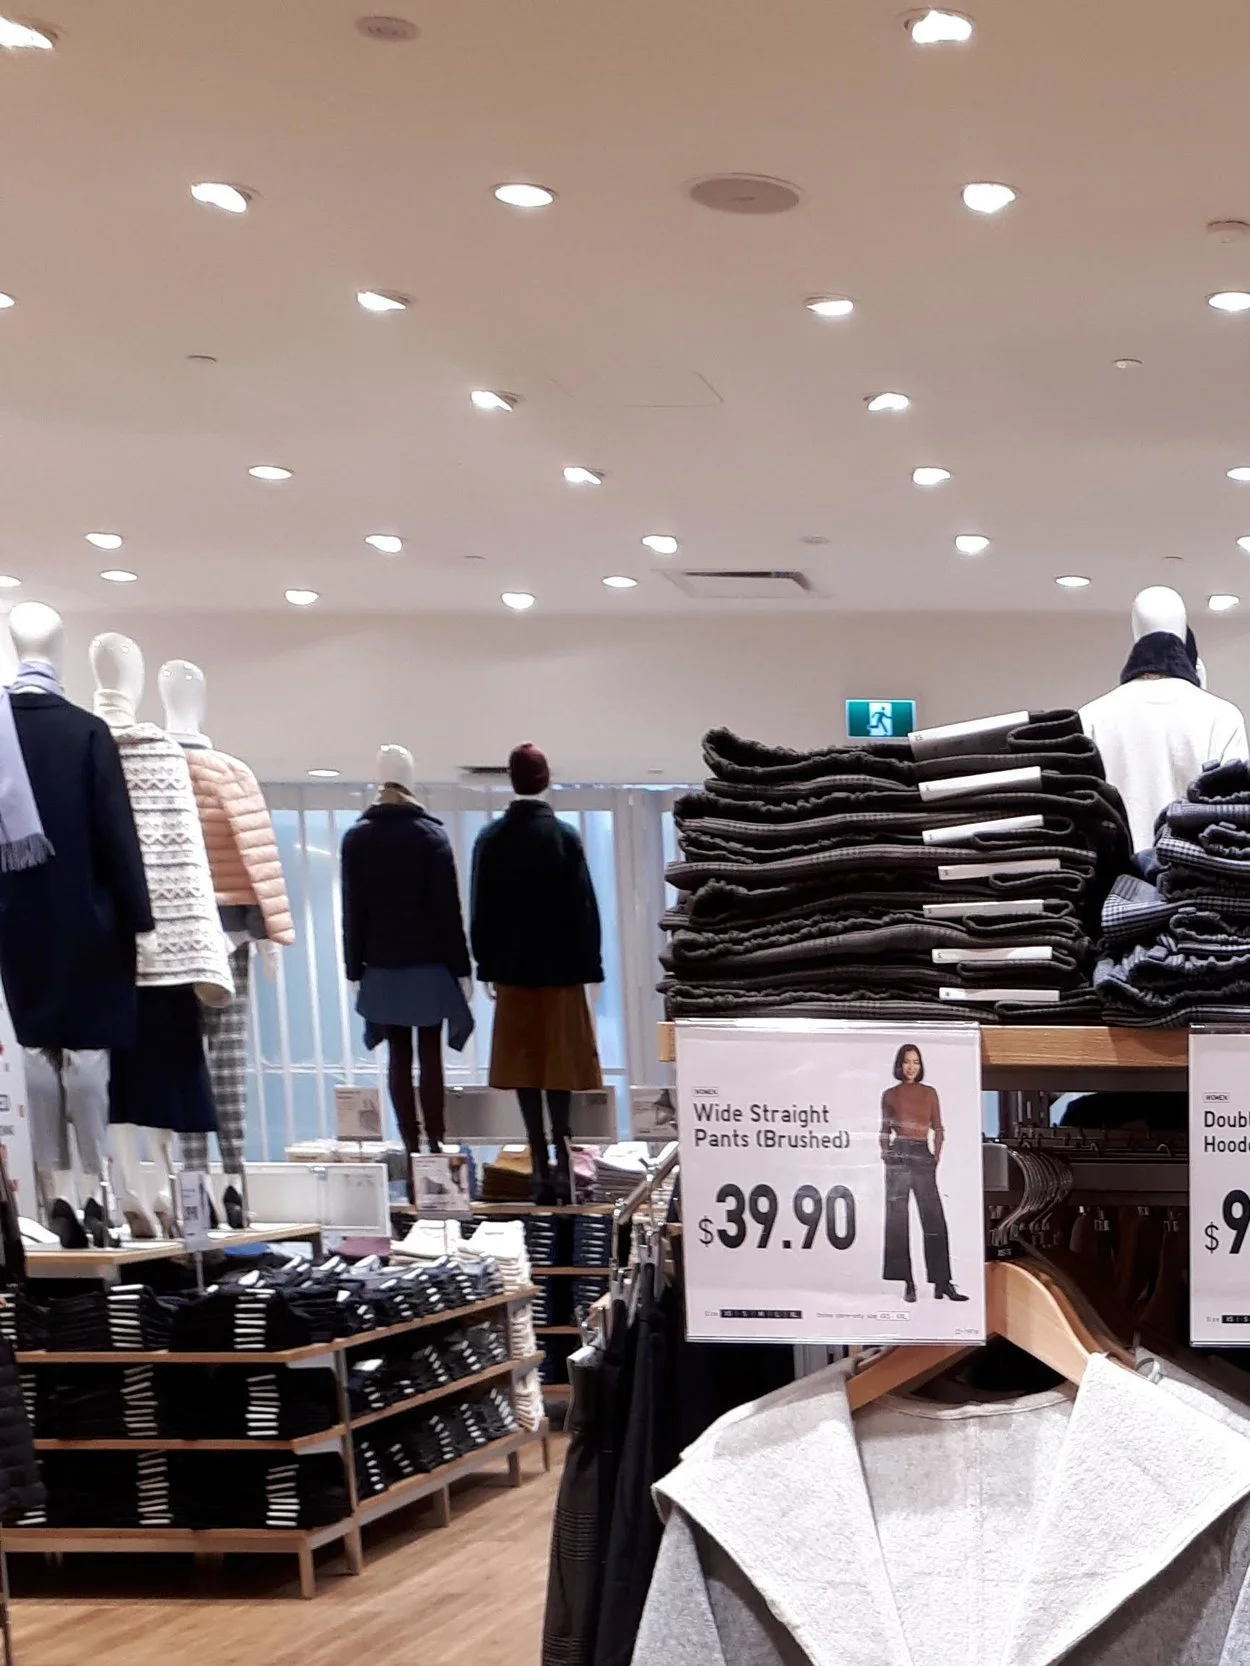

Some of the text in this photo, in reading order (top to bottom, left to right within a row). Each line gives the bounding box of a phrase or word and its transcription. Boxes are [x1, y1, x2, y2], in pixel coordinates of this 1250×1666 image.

[692, 1103, 830, 1129] Wide Straight
[694, 1128, 850, 1149] Pants (Brushed)
[698, 1183, 856, 1251] $39.90
